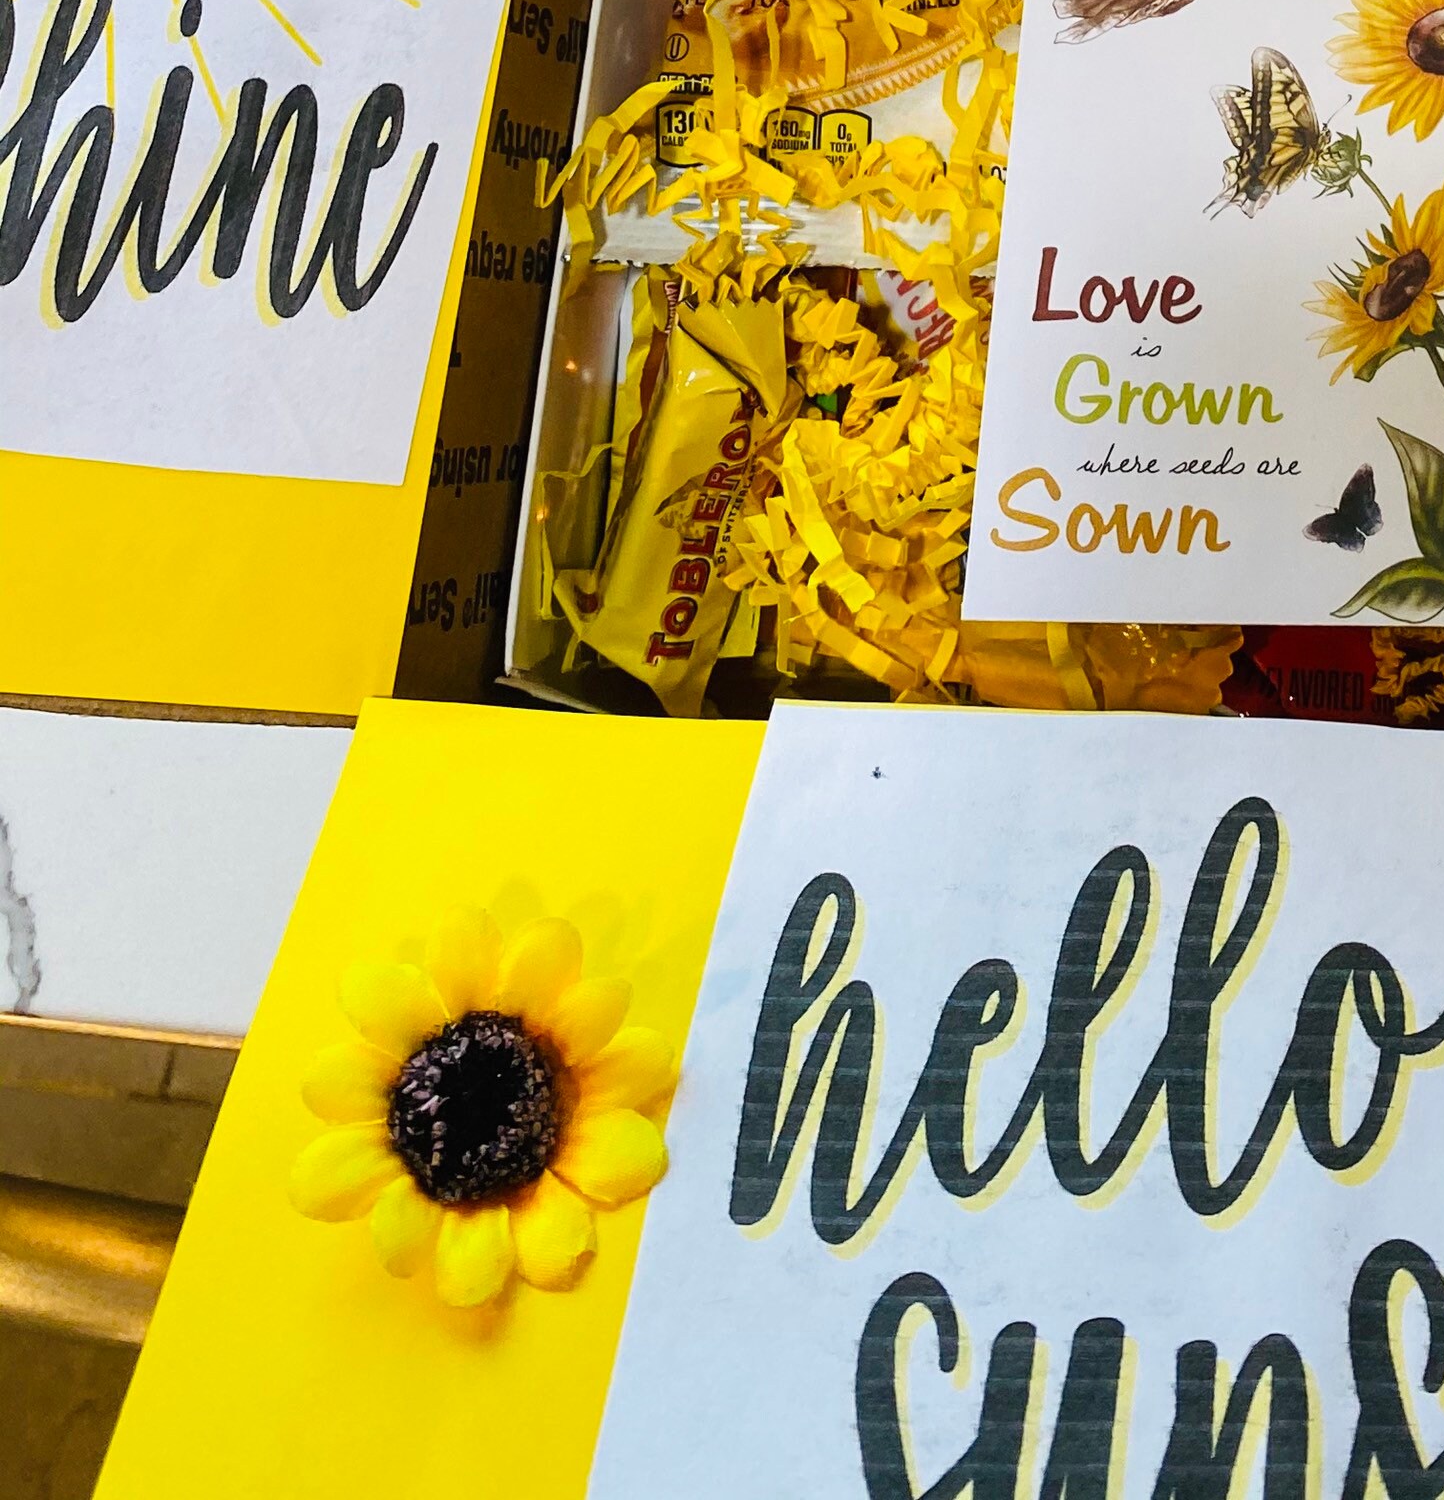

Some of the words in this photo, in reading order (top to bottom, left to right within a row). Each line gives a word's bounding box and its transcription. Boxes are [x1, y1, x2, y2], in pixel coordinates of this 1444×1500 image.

[1031, 245, 1203, 325] Love
[1130, 337, 1163, 358] is
[1053, 353, 1285, 427] Grown
[1076, 442, 1161, 476] where
[1168, 444, 1247, 476] seeds
[1256, 455, 1302, 477] are
[989, 466, 1232, 556] Sown
